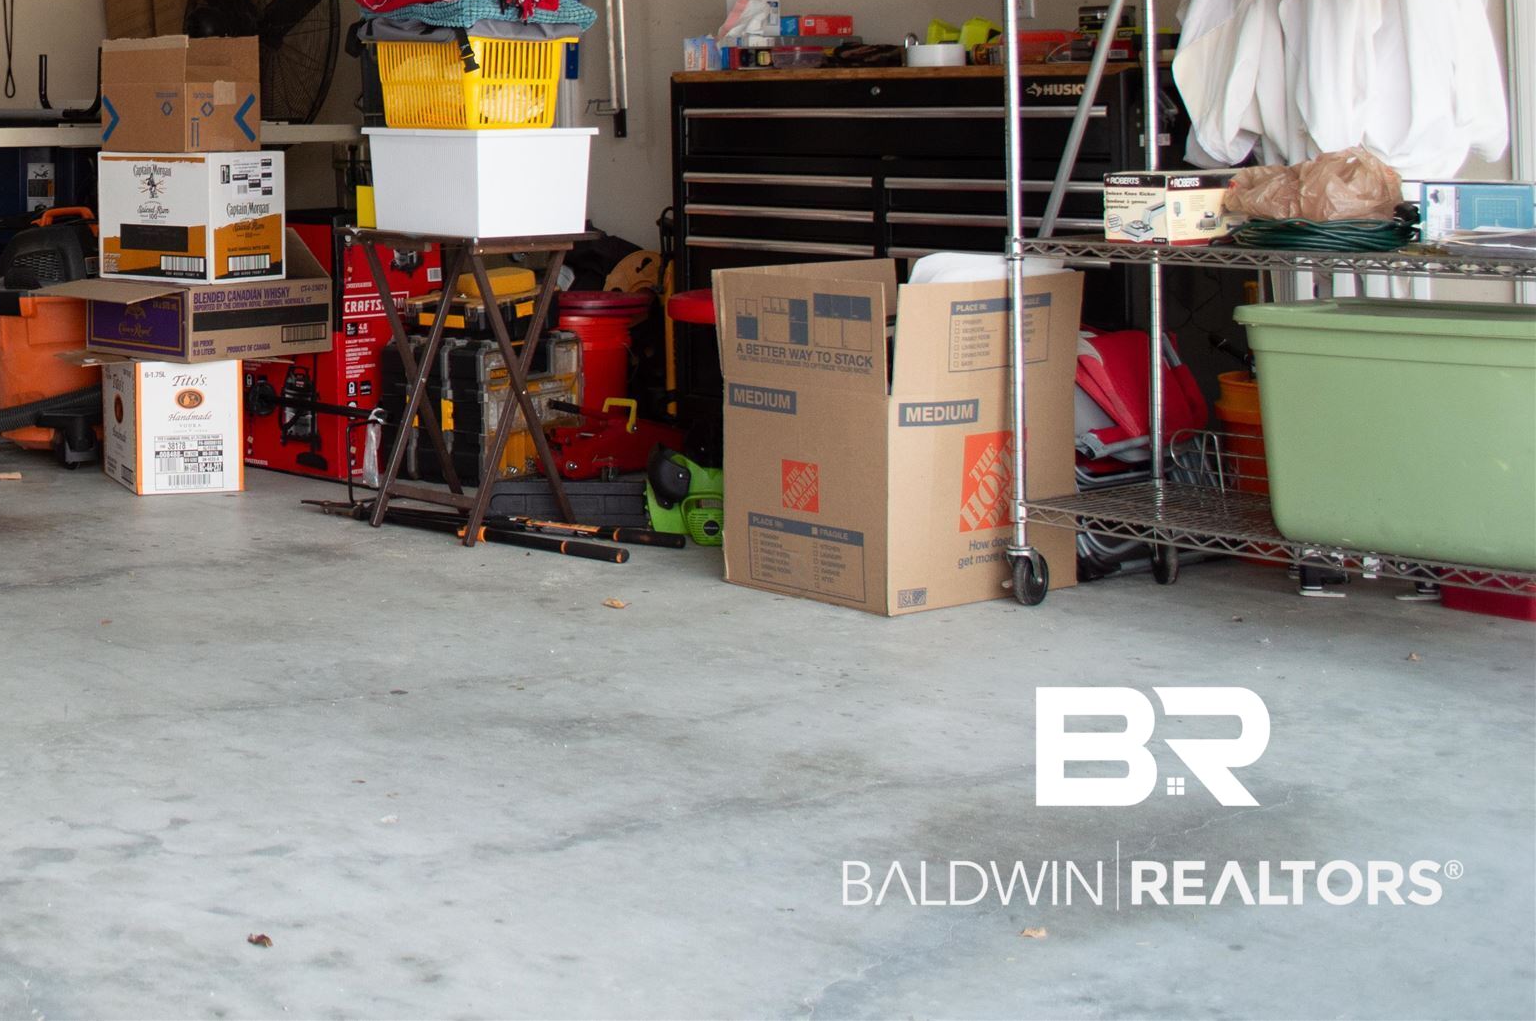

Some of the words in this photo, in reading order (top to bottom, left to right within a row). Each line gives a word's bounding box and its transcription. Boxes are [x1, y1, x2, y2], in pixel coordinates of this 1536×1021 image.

[133, 164, 152, 177] Captain
[153, 165, 171, 177] Morgan
[1173, 178, 1200, 187] ROBERTS
[226, 202, 248, 218] Captain
[249, 202, 270, 216] Morgan
[193, 291, 225, 304] BLENDED
[227, 288, 262, 301] CANADIAN
[264, 286, 290, 299] WHISKY
[955, 304, 976, 312] PLACE
[227, 345, 246, 353] PRODUCT
[254, 343, 271, 351] CANADA
[736, 343, 744, 353] A
[746, 344, 786, 358] BETTER
[788, 348, 814, 360] WAY
[816, 351, 832, 363] TO
[834, 353, 873, 368] STACK
[173, 374, 208, 387] Tito's
[733, 388, 791, 409] MEDIUM
[169, 411, 212, 421] Handmade
[905, 404, 974, 422] MEDIUM
[969, 443, 998, 482] THE
[786, 467, 801, 484] THE
[783, 464, 818, 507] HOME
[796, 481, 818, 510] DEPOT
[819, 527, 848, 539] FRAGILE
[969, 540, 989, 550] How
[958, 555, 974, 569] get
[976, 552, 999, 563] more
